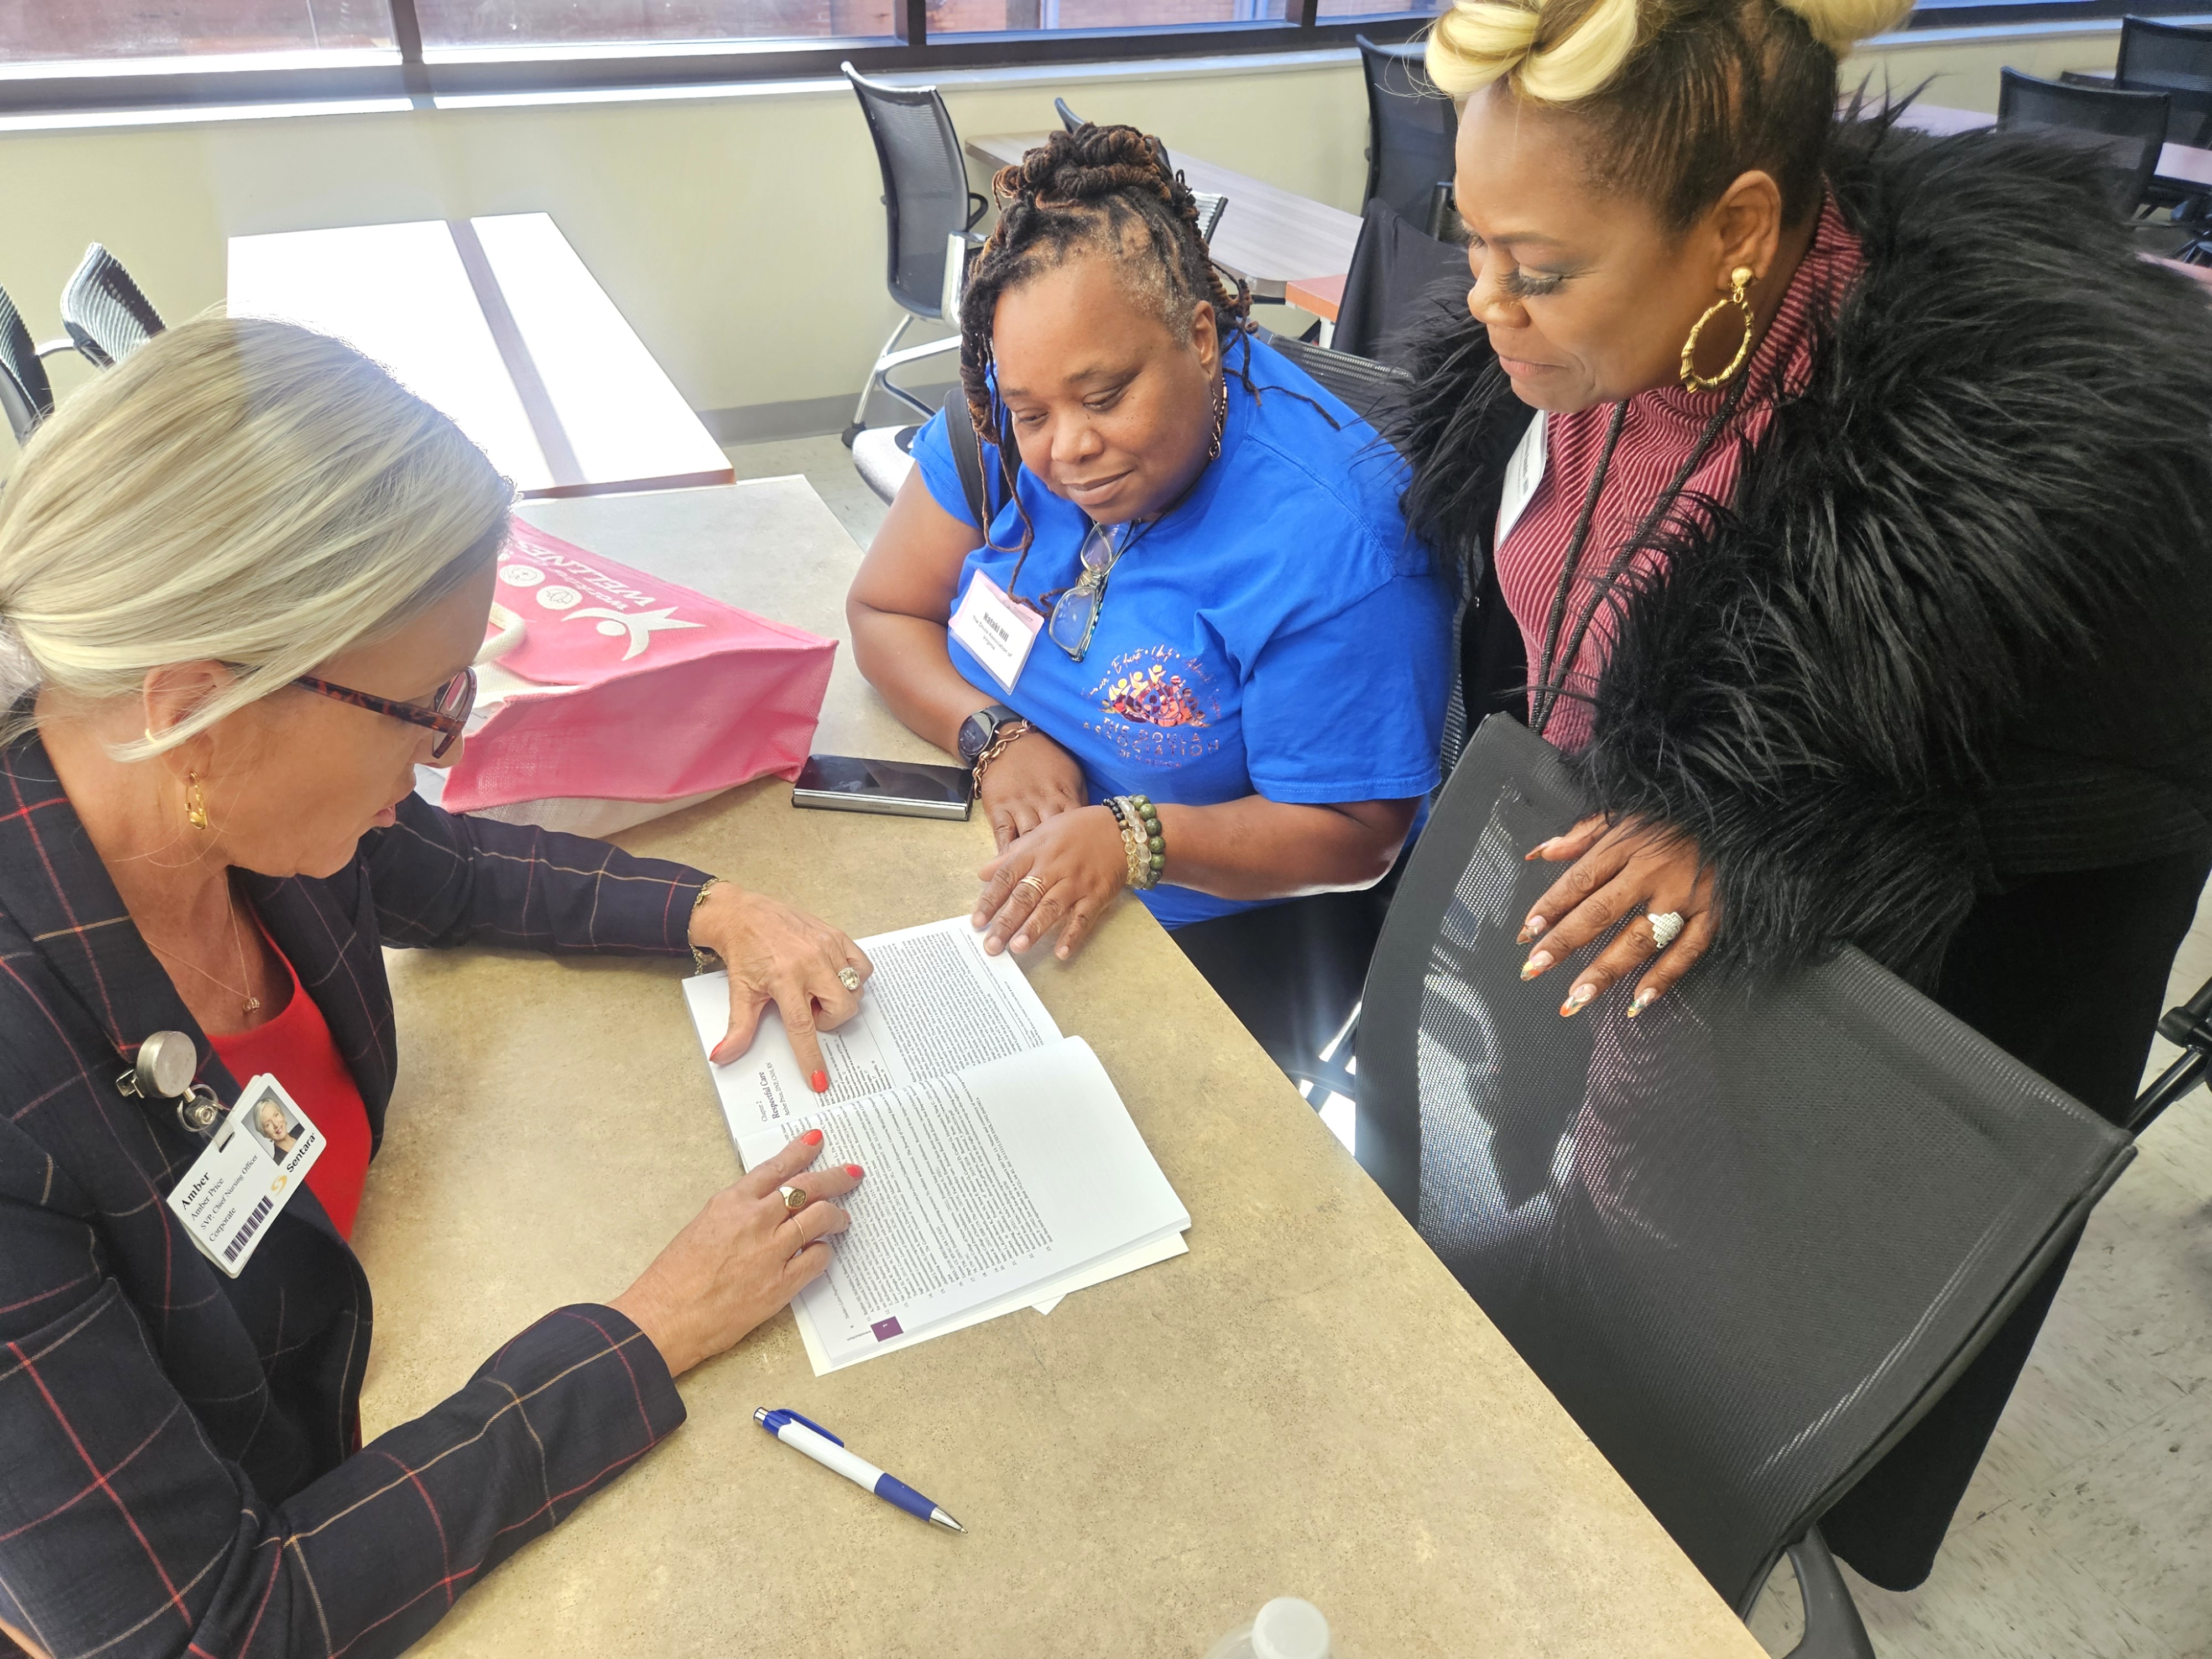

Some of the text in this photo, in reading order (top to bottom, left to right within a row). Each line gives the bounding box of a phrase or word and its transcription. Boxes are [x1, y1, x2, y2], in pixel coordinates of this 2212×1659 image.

[516, 539, 656, 607] WELLNES
[983, 612, 1009, 642] Nataki Hill
[978, 622, 989, 634] Doula
[989, 633, 1008, 654] Association
[983, 635, 995, 650] Virginia
[1103, 717, 1201, 744] THE DOULA
[1119, 749, 1130, 759] OF
[759, 1072, 780, 1119] Respectful Care
[759, 1104, 768, 1121] Chapter
[950, 1099, 959, 1114] achieving
[961, 1120, 969, 1135] direction
[954, 1137, 965, 1154] Retrieved
[286, 1135, 316, 1173] Sentara
[926, 1161, 935, 1175] practice
[938, 1159, 948, 1175] Essential
[182, 1172, 210, 1211] Amber
[212, 1195, 226, 1214] Chief
[225, 1174, 244, 1198] Nursing
[242, 1154, 258, 1175] Officer
[936, 1183, 946, 1199] Evidence
[943, 1182, 951, 1196] October
[191, 1178, 224, 1221] Amber Price
[1019, 1197, 1027, 1210] another
[986, 1200, 997, 1218] Evaluation
[209, 1207, 237, 1242] Corporate
[967, 1243, 975, 1255] College
[978, 1238, 987, 1250] College
[973, 1255, 984, 1271] American
[985, 1250, 995, 1266] American
